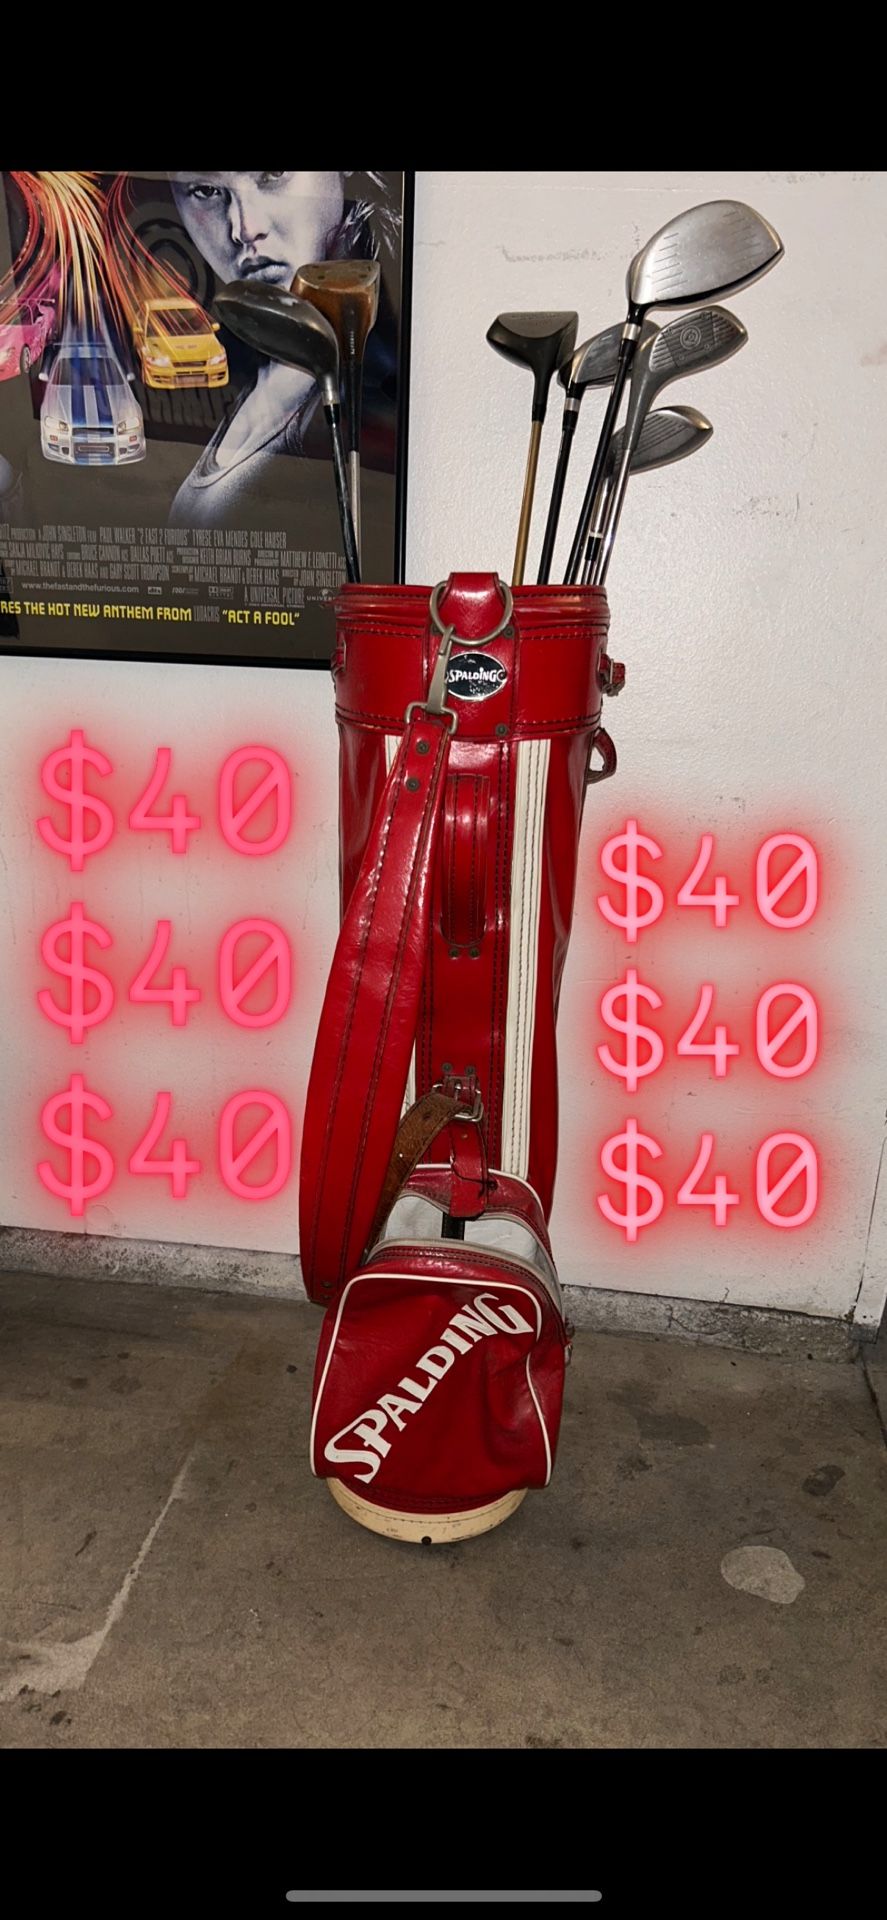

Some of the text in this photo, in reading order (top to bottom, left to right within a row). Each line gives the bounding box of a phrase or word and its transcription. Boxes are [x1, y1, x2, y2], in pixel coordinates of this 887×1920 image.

[99, 527, 112, 543] PAUL
[113, 528, 136, 544] WALKER
[144, 528, 158, 545] FAST
[192, 529, 212, 547] TYRESE
[213, 530, 224, 547] EVA
[225, 530, 248, 548] MENDES
[250, 531, 264, 549] COLE
[264, 531, 287, 549] HAUSER
[280, 550, 307, 568] MATTHEW
[66, 561, 83, 578] DEREK
[83, 562, 99, 579] HAAS
[140, 563, 169, 581] THOMPSON
[194, 565, 219, 583] MICHAEL
[246, 567, 263, 585] DEREK
[264, 568, 280, 585] HAAS
[299, 570, 315, 587] JOHN
[21, 582, 140, 594] www.thefastandthefurious.com
[243, 585, 249, 604] A
[249, 586, 280, 604] UNIVERSAL
[282, 587, 305, 605] PICTURE
[23, 602, 46, 615] THE
[48, 603, 71, 616] HOT
[73, 604, 100, 618] NEW
[103, 605, 154, 620] ANTHEM
[156, 607, 192, 622] FROM
[222, 609, 250, 624] "ACT
[253, 611, 262, 624] A
[265, 612, 300, 626] FOOL"
[324, 1292, 534, 1485] SPALDING
